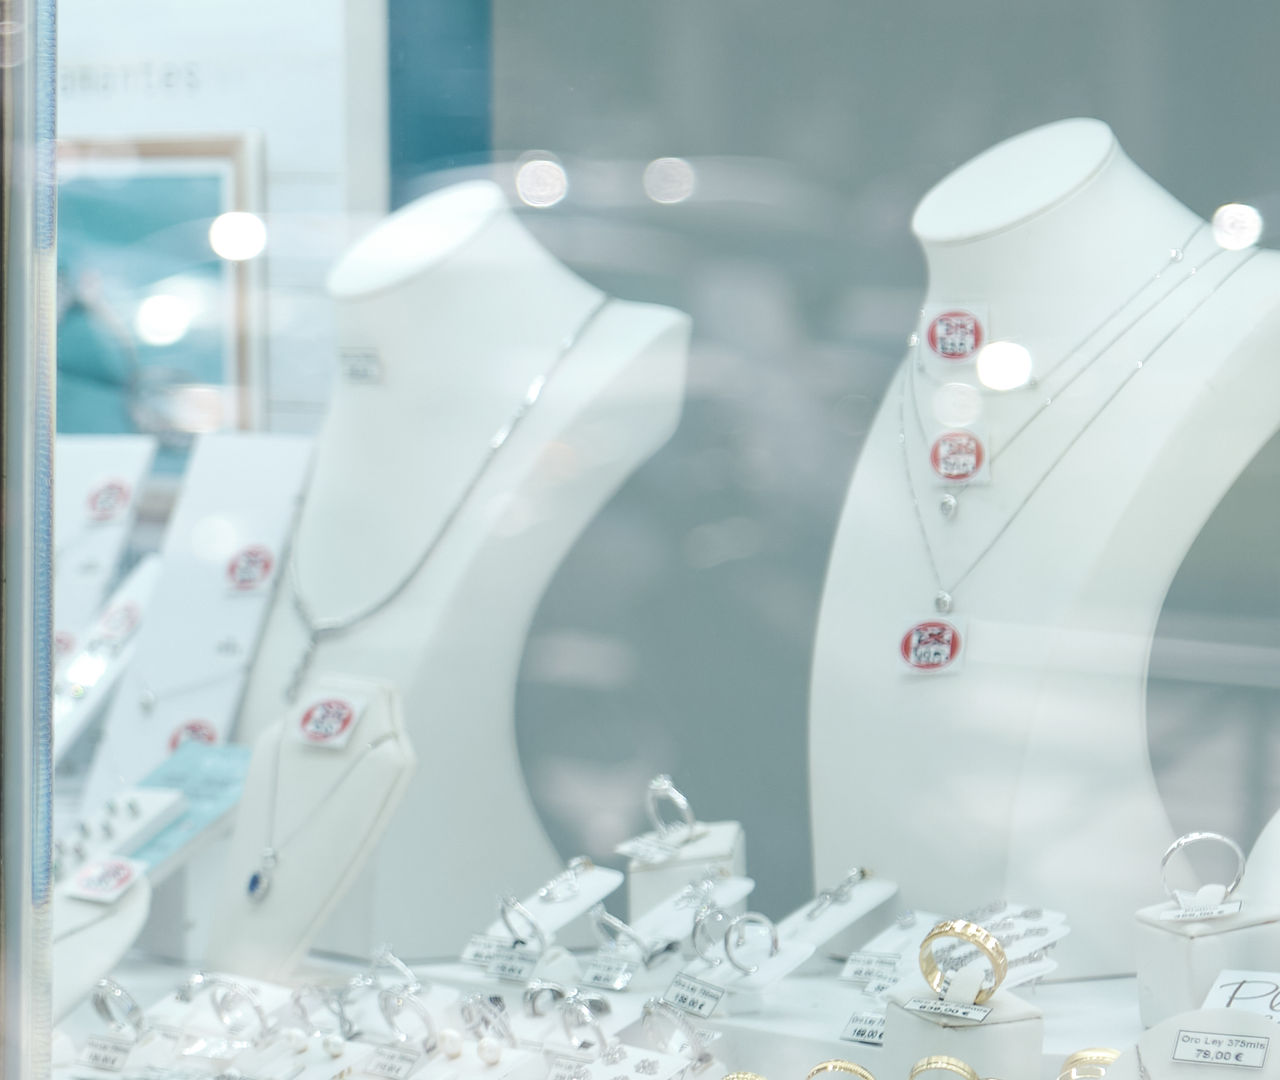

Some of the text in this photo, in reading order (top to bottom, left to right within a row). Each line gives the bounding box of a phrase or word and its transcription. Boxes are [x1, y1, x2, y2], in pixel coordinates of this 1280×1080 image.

[1181, 1034, 1266, 1050] Oro Ley 375mls
[1235, 1052, 1244, 1062] €
